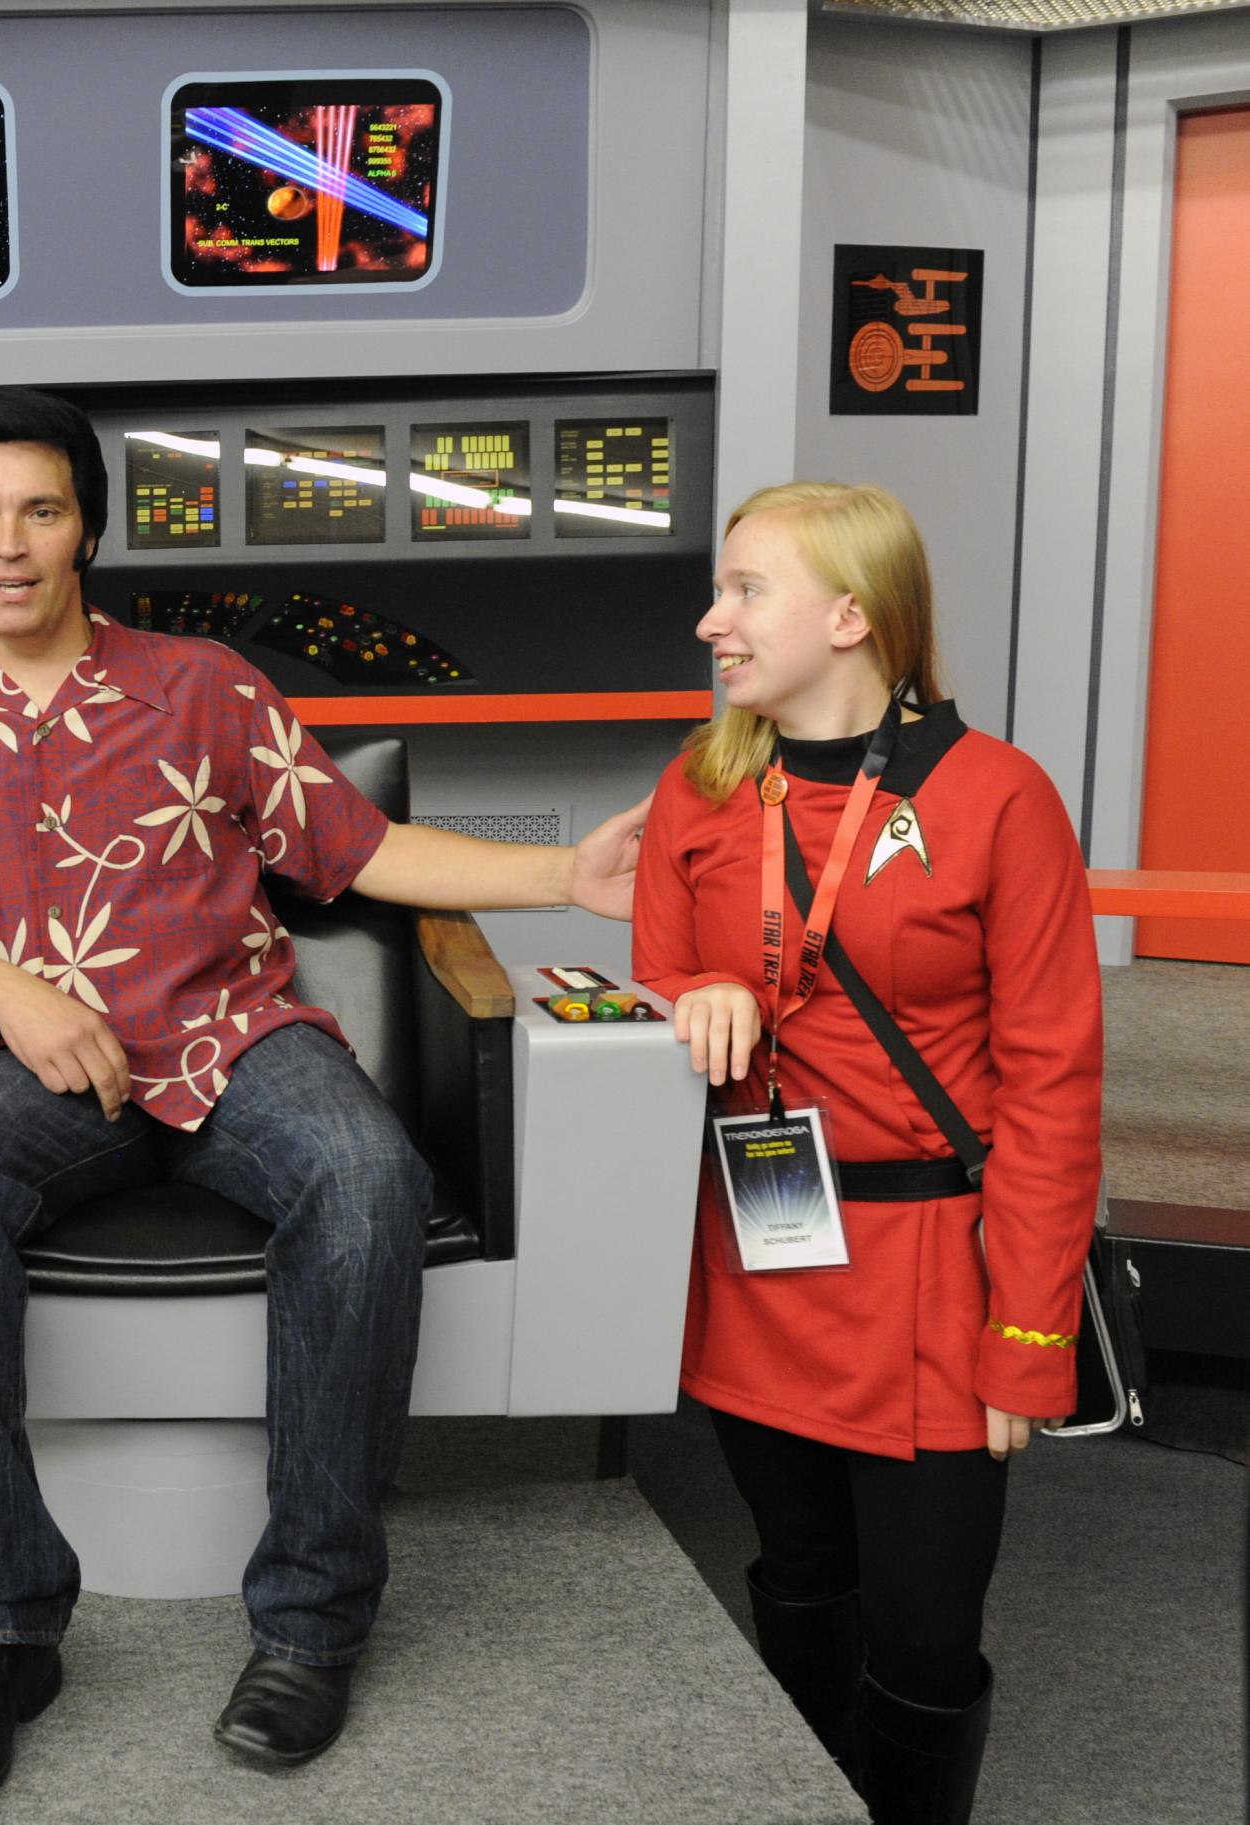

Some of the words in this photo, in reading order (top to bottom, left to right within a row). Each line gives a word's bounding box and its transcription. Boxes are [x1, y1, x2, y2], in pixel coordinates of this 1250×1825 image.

[241, 238, 265, 246] TRANS
[265, 238, 299, 246] VECTORS
[763, 910, 782, 948] STAR
[800, 929, 824, 968] STAR
[763, 952, 780, 988] TREK
[795, 966, 816, 998] TREK
[724, 1126, 810, 1141] TREKONDEROGA
[766, 1223, 804, 1232] TIFFANY
[762, 1235, 812, 1246] SCHUBERT
